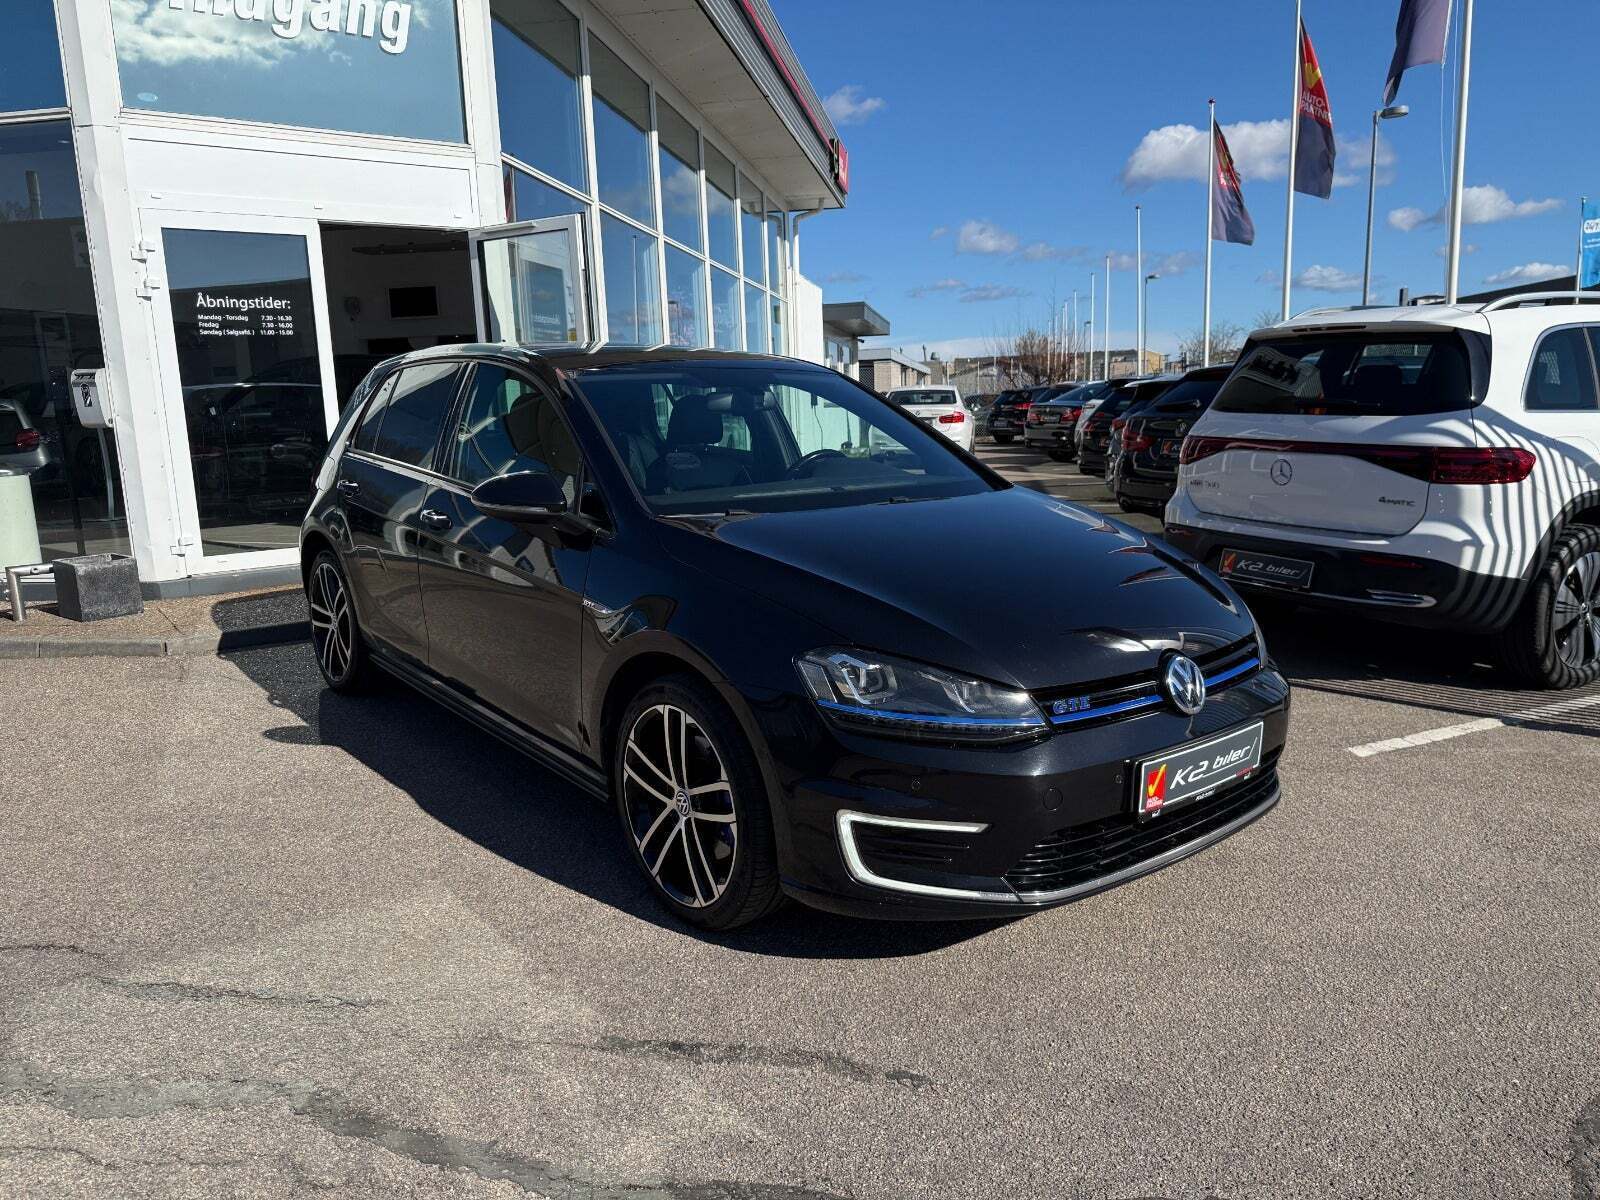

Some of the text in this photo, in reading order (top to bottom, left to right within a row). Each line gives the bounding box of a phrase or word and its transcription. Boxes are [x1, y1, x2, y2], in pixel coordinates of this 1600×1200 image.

[168, 0, 411, 54] gang
[196, 292, 291, 311] Åbningstider:
[226, 314, 249, 322] Torsdag
[1236, 559, 1264, 572] K2
[1265, 564, 1301, 576] biler
[1052, 695, 1091, 715] GTE
[1169, 760, 1210, 790] K2
[1212, 744, 1252, 770] biler
